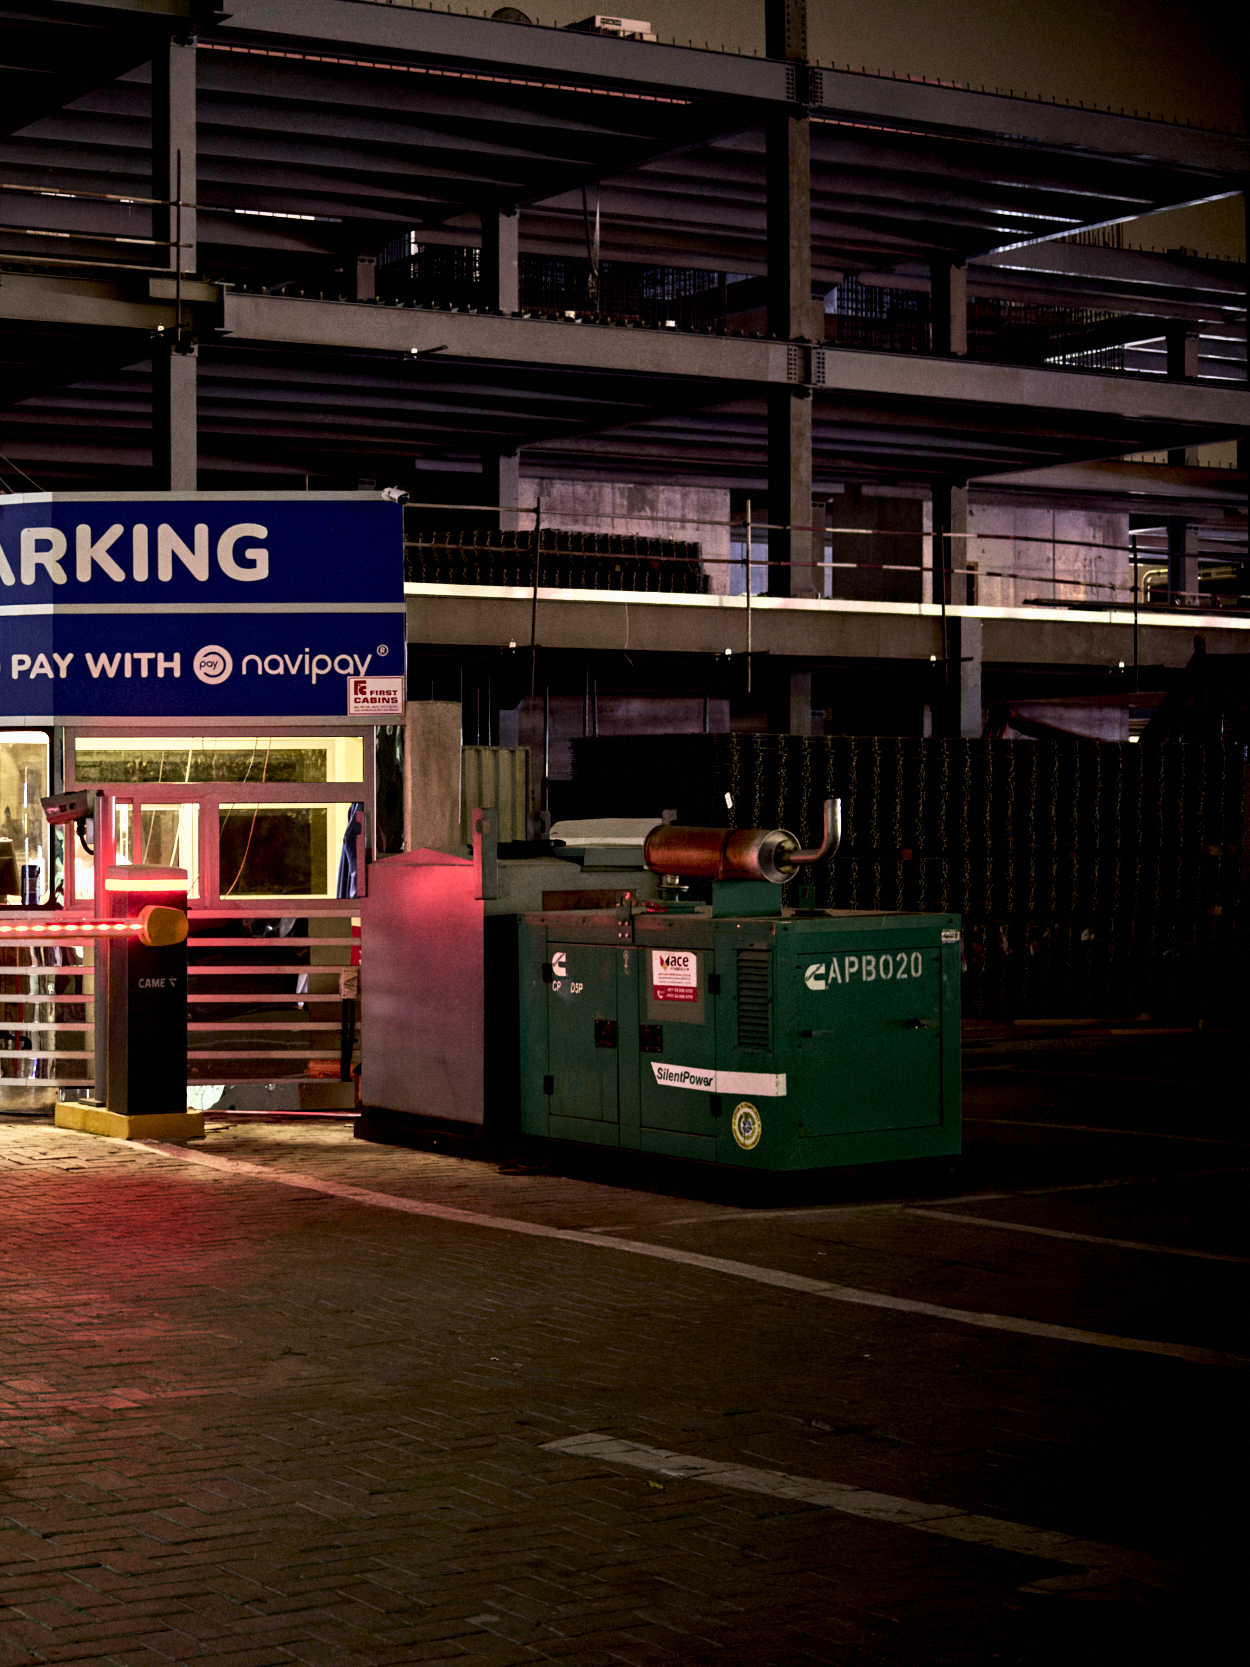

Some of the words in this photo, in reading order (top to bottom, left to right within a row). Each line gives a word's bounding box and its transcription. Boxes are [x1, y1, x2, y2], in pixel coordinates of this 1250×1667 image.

[11, 652, 75, 680] PAY
[85, 652, 182, 679] WITH
[199, 659, 219, 671] pay
[138, 977, 166, 989] CAME
[656, 1067, 714, 1087] SilentPower
